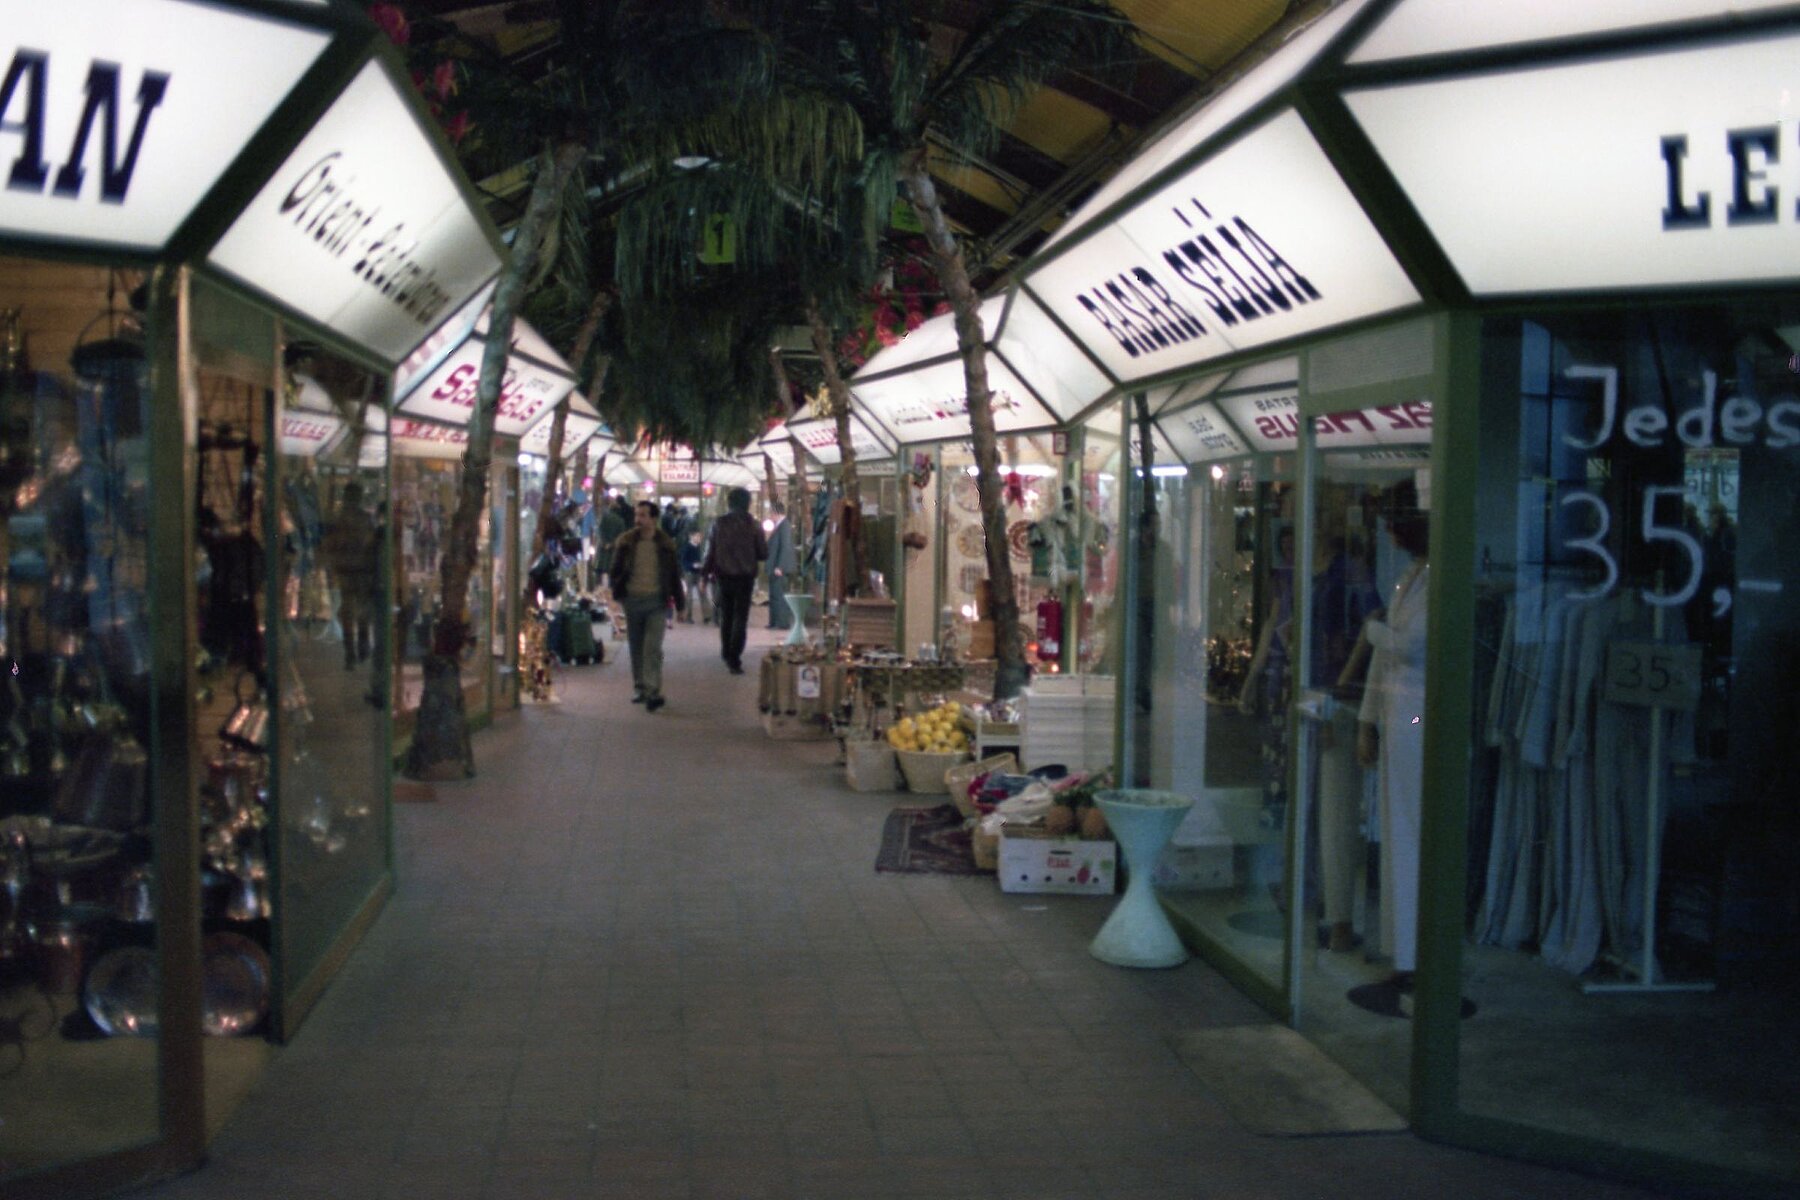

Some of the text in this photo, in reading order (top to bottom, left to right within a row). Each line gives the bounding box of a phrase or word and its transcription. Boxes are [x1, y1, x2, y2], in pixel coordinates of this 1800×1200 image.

[1660, 123, 1800, 231] LE
[1077, 293, 1209, 358] BASAR
[1562, 365, 1800, 449] Jedes
